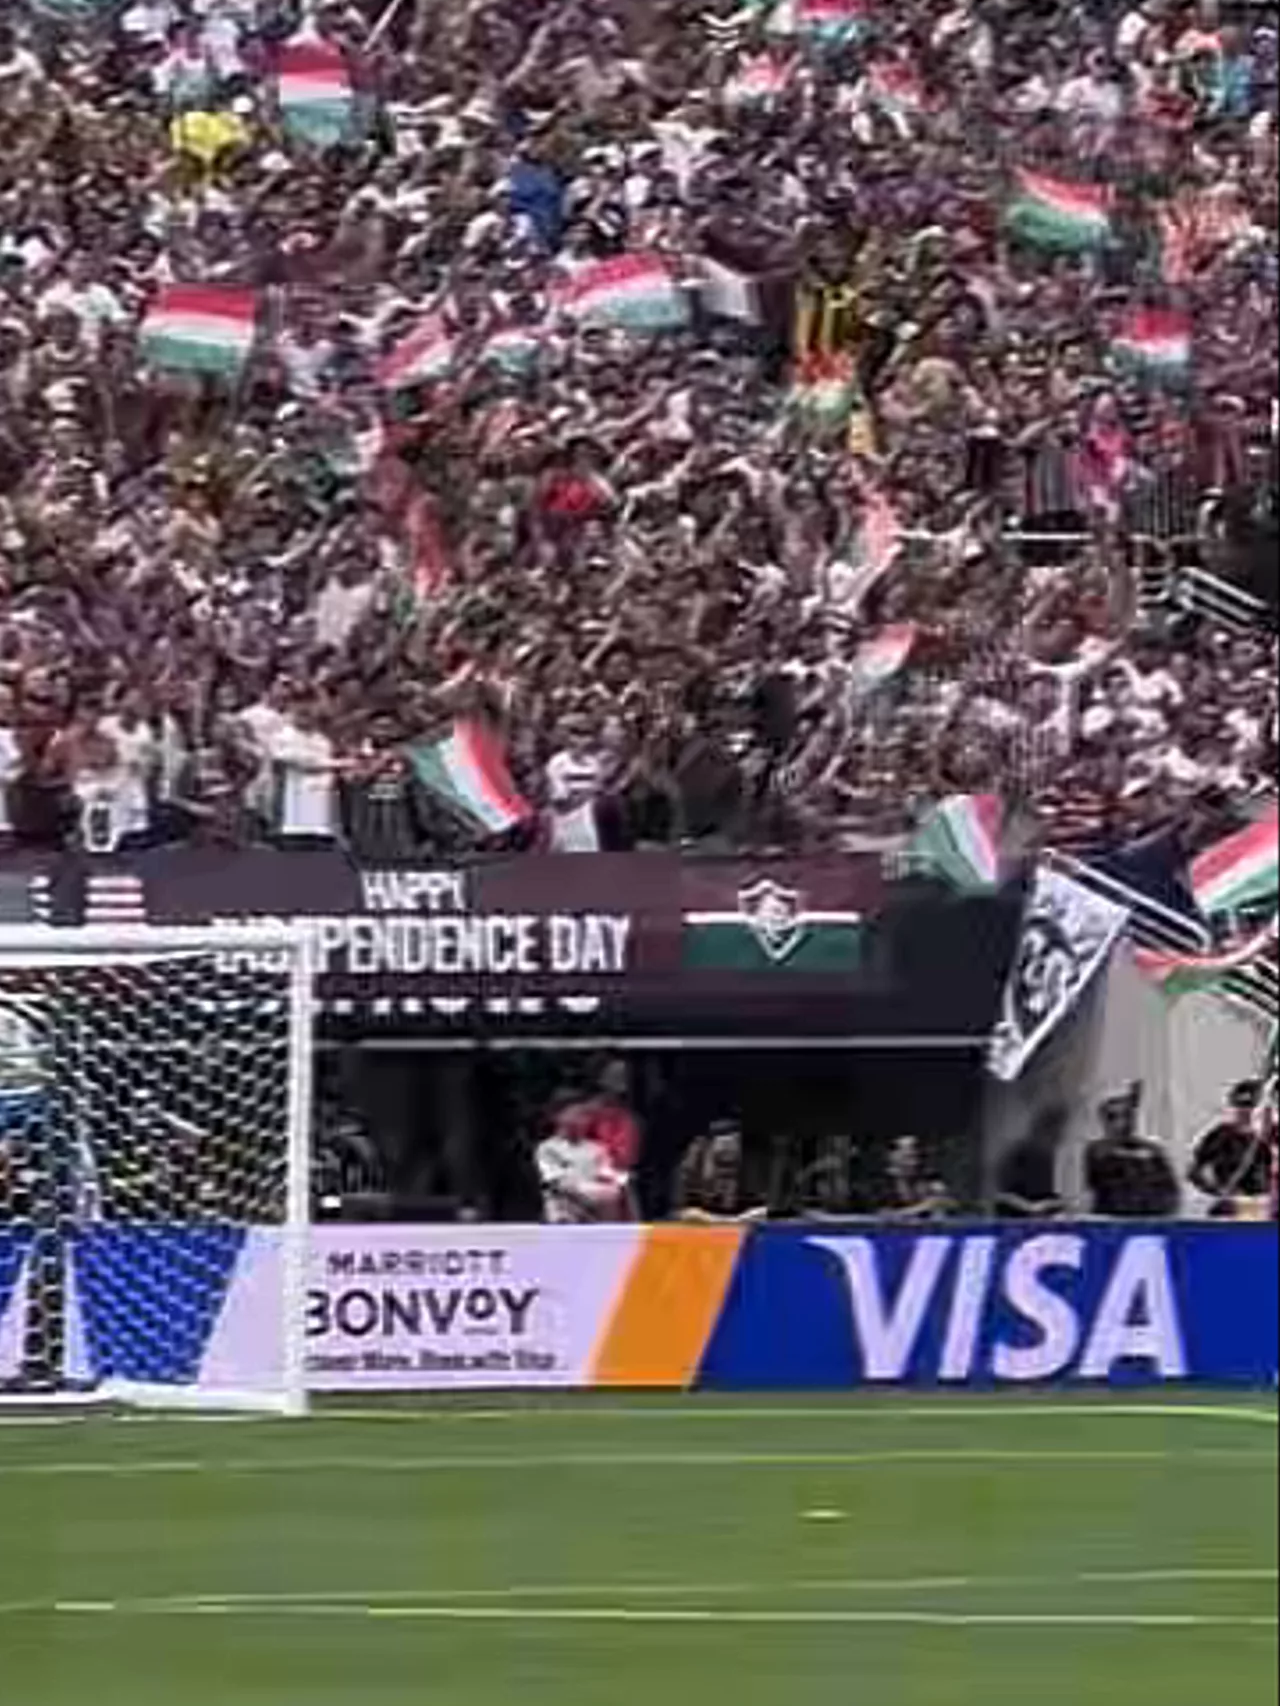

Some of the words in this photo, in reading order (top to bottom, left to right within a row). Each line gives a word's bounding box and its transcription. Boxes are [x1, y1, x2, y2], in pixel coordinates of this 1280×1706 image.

[361, 870, 465, 910] HAPPY
[549, 915, 631, 972] DAY
[804, 1234, 1187, 1379] VISA
